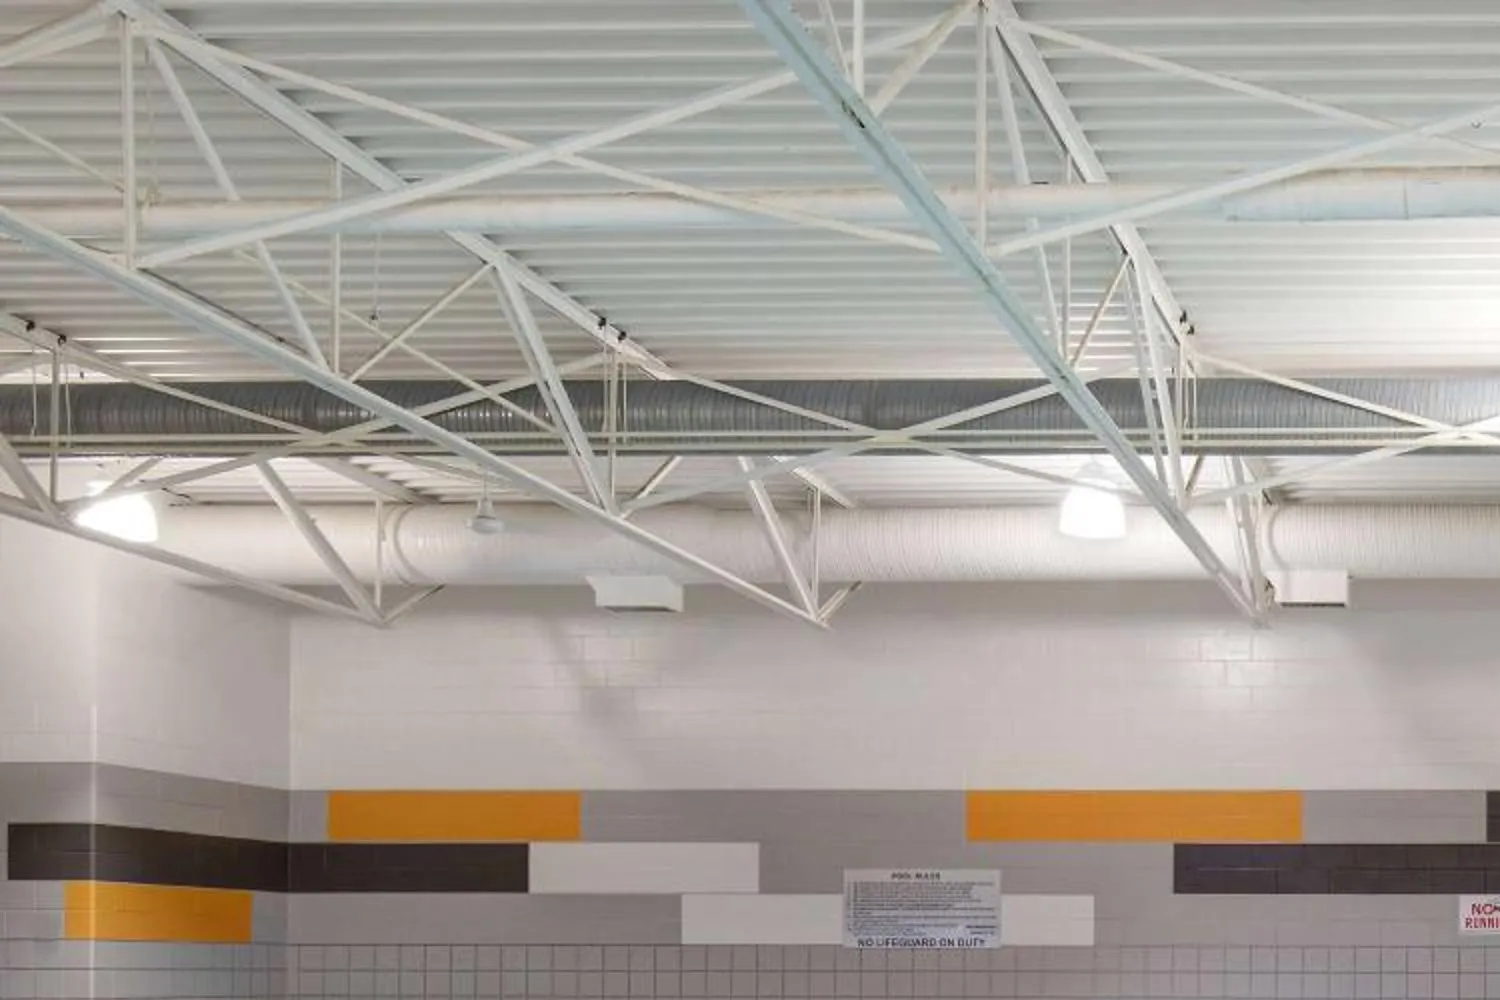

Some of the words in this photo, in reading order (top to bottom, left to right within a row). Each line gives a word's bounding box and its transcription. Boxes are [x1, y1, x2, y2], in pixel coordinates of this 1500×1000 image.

[1471, 903, 1493, 915] NO
[857, 938, 874, 947] NO
[876, 938, 937, 947] LIFEGUARD
[939, 938, 955, 947] ON
[957, 938, 986, 947] DUTY
